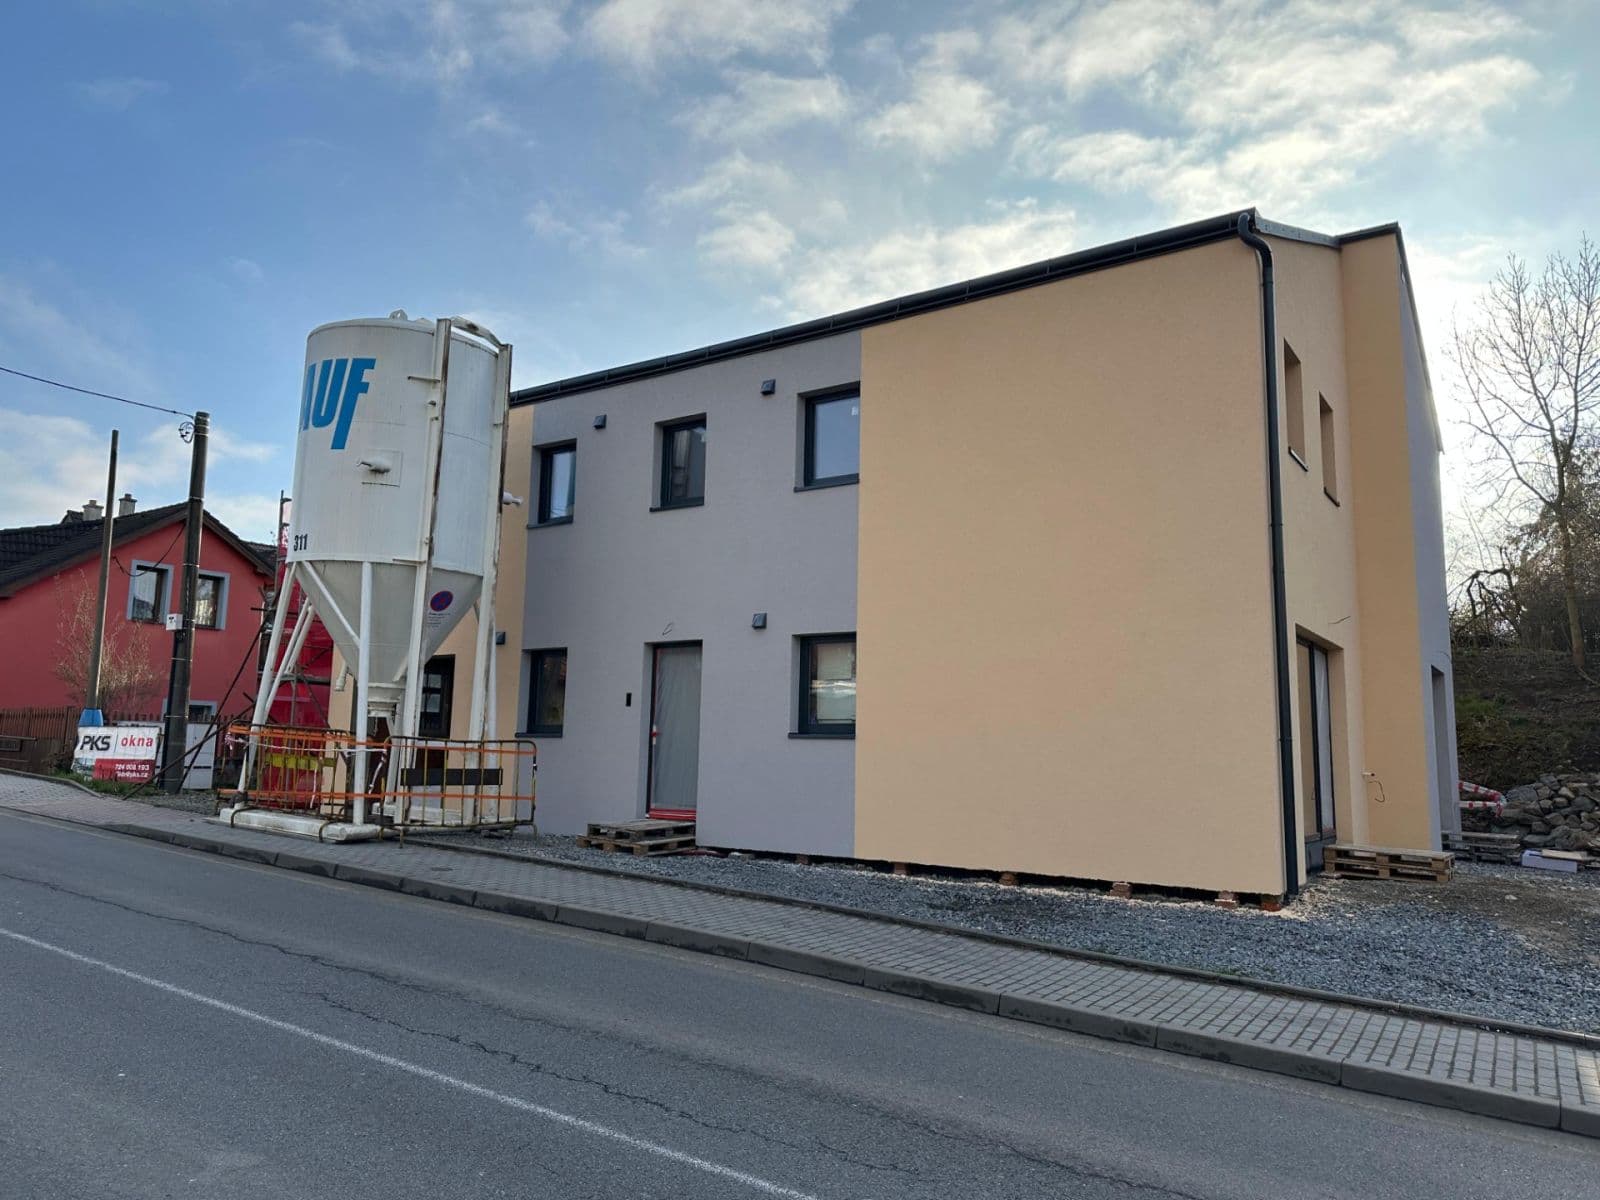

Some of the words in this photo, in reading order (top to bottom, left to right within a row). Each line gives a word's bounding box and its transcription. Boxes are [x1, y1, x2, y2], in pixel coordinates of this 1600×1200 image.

[293, 533, 308, 552] 311
[80, 735, 111, 751] PKS
[121, 734, 154, 747] okna
